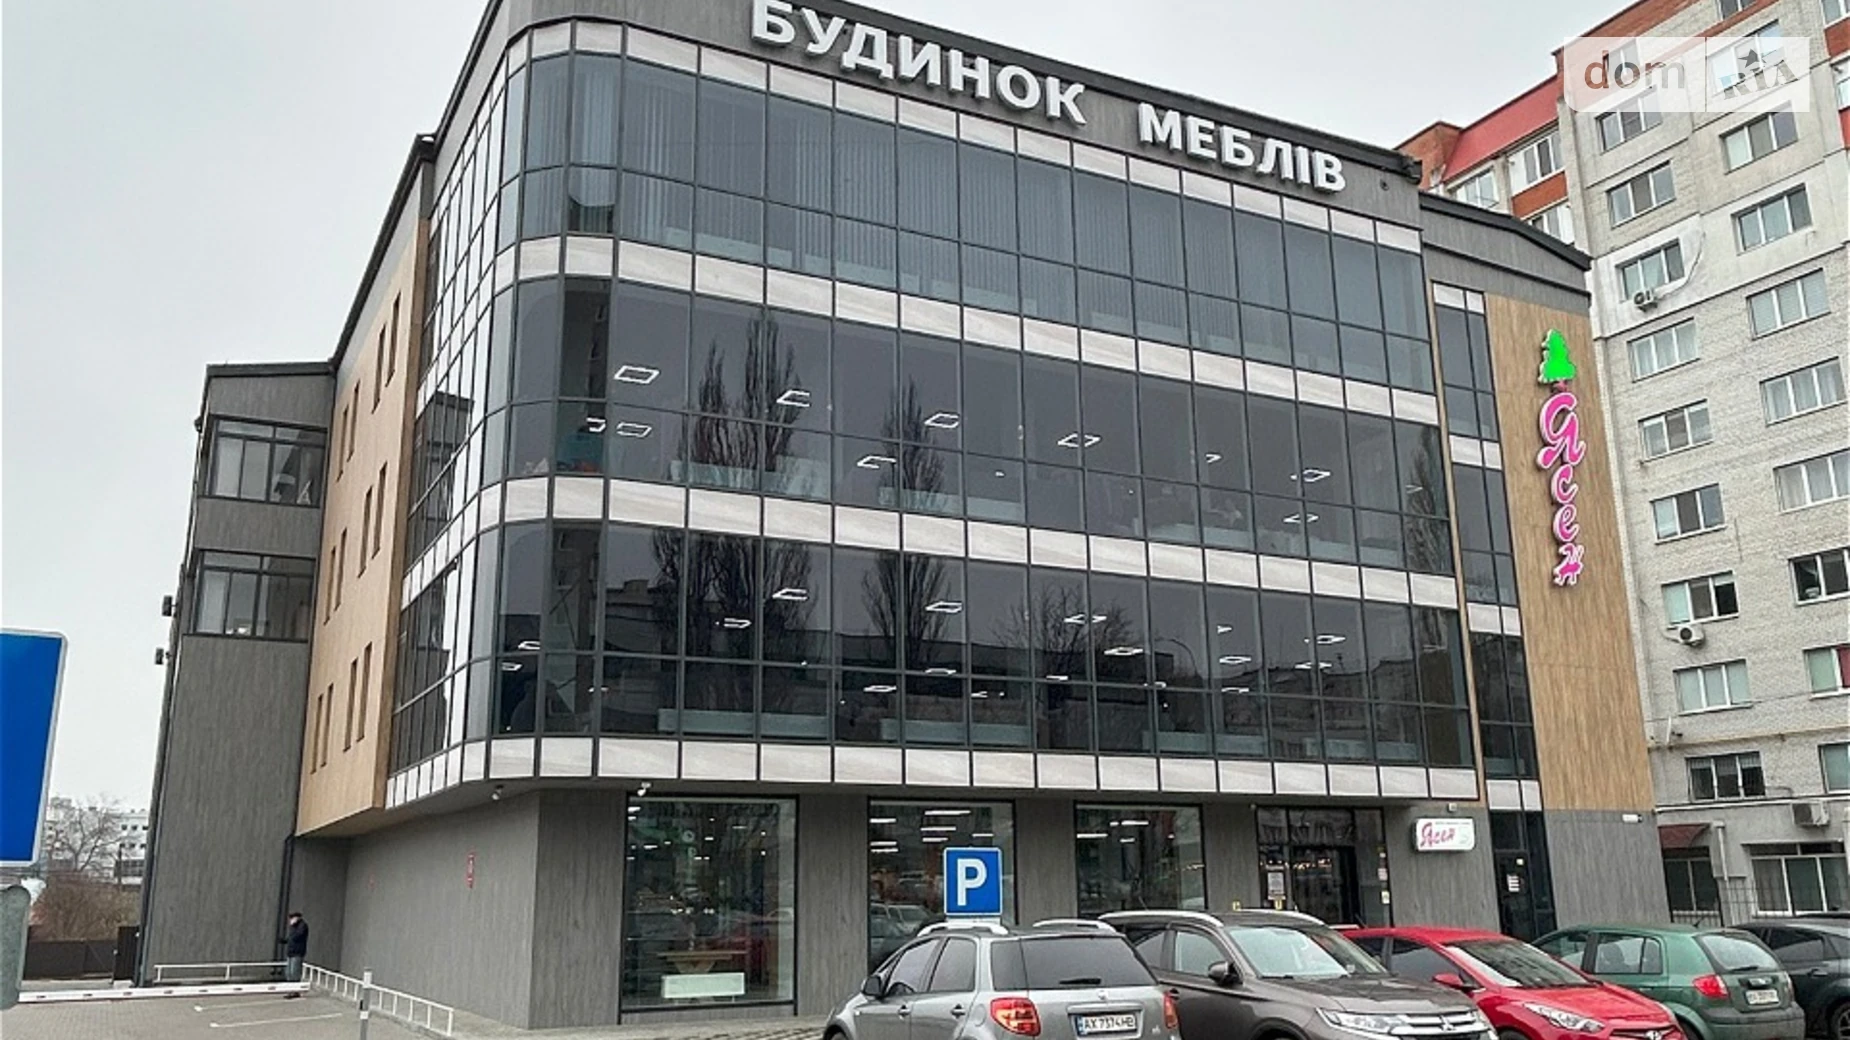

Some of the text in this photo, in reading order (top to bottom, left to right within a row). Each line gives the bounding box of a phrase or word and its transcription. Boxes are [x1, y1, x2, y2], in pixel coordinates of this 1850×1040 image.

[751, 0, 1346, 193] БУДИНОК МЕБЛІВ
[957, 858, 987, 906] P
